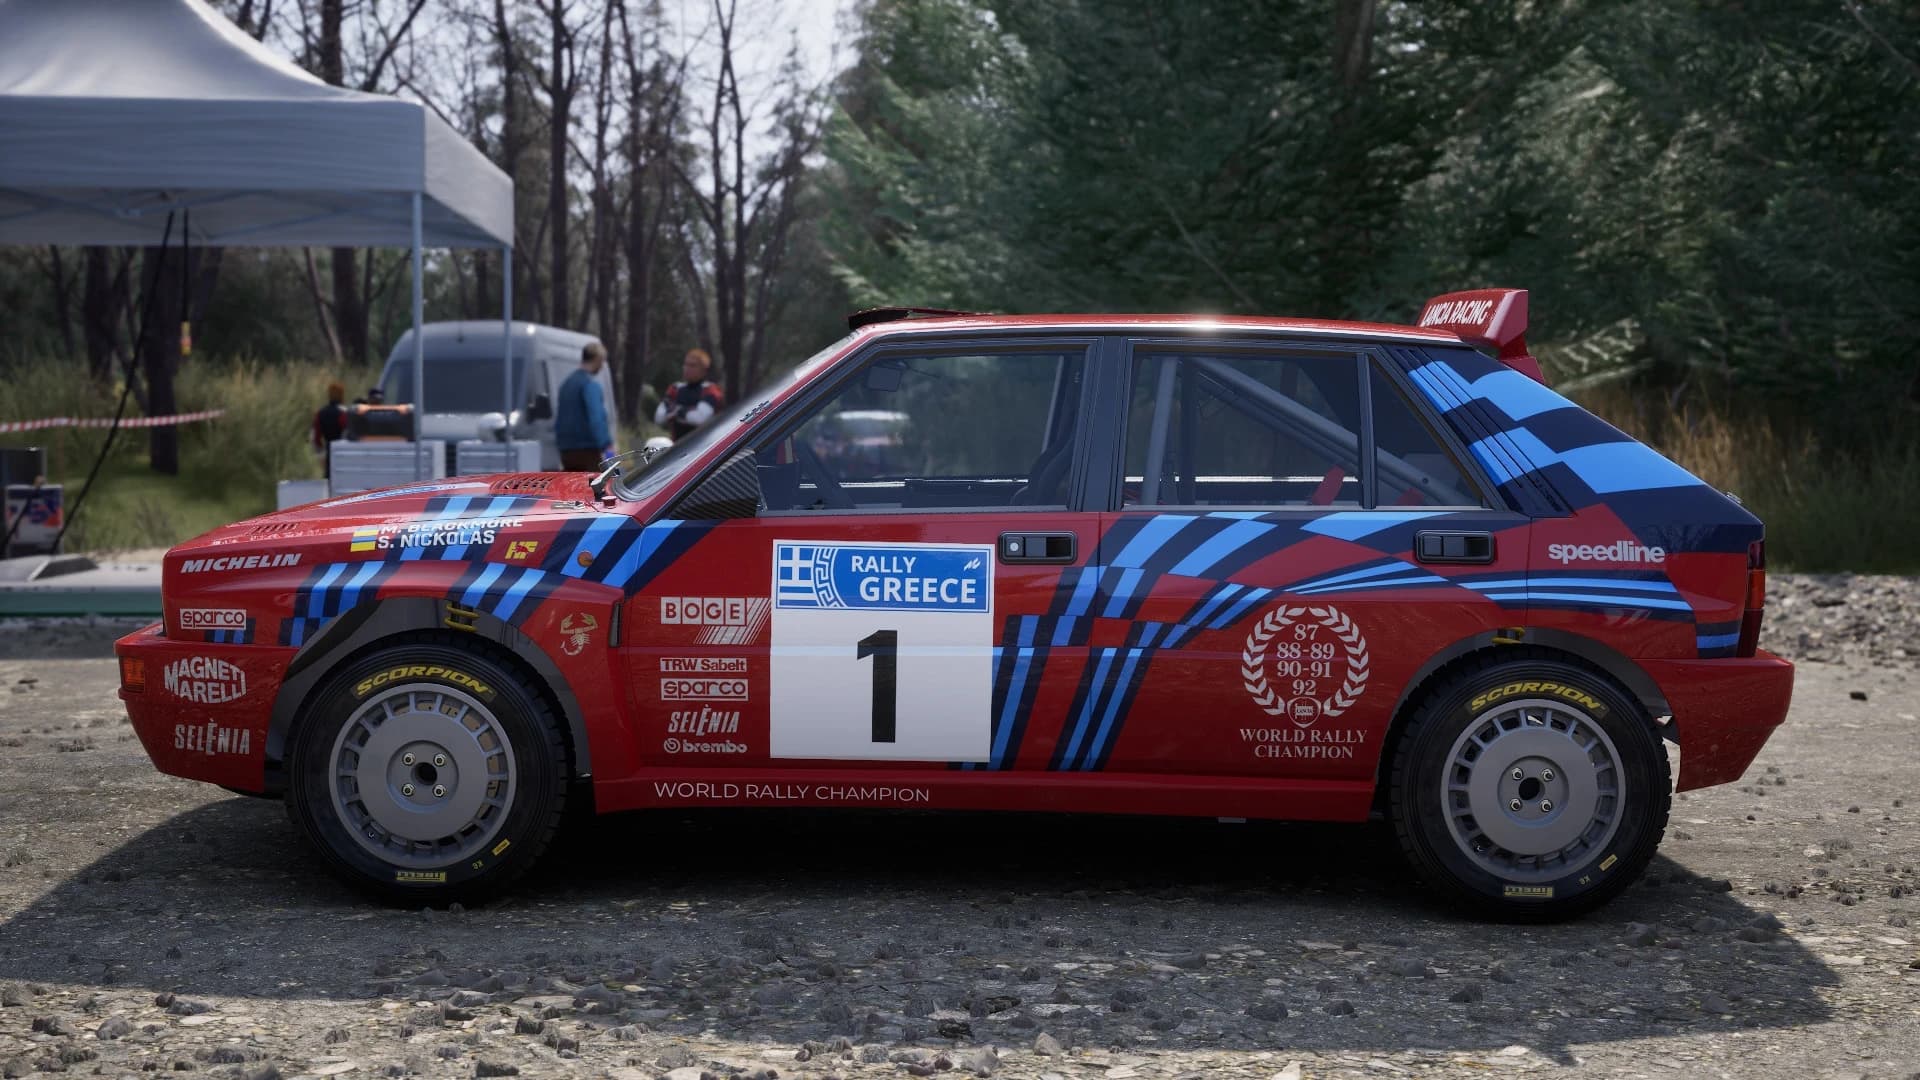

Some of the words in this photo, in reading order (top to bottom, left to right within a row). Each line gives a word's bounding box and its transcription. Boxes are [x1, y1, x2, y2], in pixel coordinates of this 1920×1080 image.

[1420, 302, 1454, 327] LANCIA
[1448, 300, 1493, 325] RACING
[408, 518, 524, 533] BLACKMORE
[377, 536, 394, 548] S.
[400, 530, 495, 548] NICKOLAS
[1548, 540, 1665, 564] speedline
[180, 553, 302, 574] MICHELIN
[851, 555, 917, 574] RALLY
[859, 576, 977, 604] GREECE
[182, 610, 246, 628] sparco
[665, 602, 740, 620] BOGE
[1294, 624, 1319, 640] 87
[1277, 642, 1335, 659] 88-89
[163, 656, 247, 687] MAGNETI
[661, 659, 698, 671] TRW
[701, 658, 746, 671] Sabelt
[1277, 661, 1333, 678] 90-91
[356, 665, 488, 696] SCORPION
[857, 629, 898, 743] 1
[1292, 679, 1317, 696] 92
[163, 676, 247, 704] MARELLI
[663, 681, 747, 699] sparco
[1471, 681, 1601, 711] SCORPION
[1240, 728, 1305, 743] WORLD
[1310, 729, 1368, 744] RALLY
[682, 739, 748, 753] brembo
[1254, 744, 1353, 759] CHAMPION
[654, 782, 739, 799] WORLD
[745, 784, 810, 800] RALLY
[815, 786, 930, 802] CHAMPION
